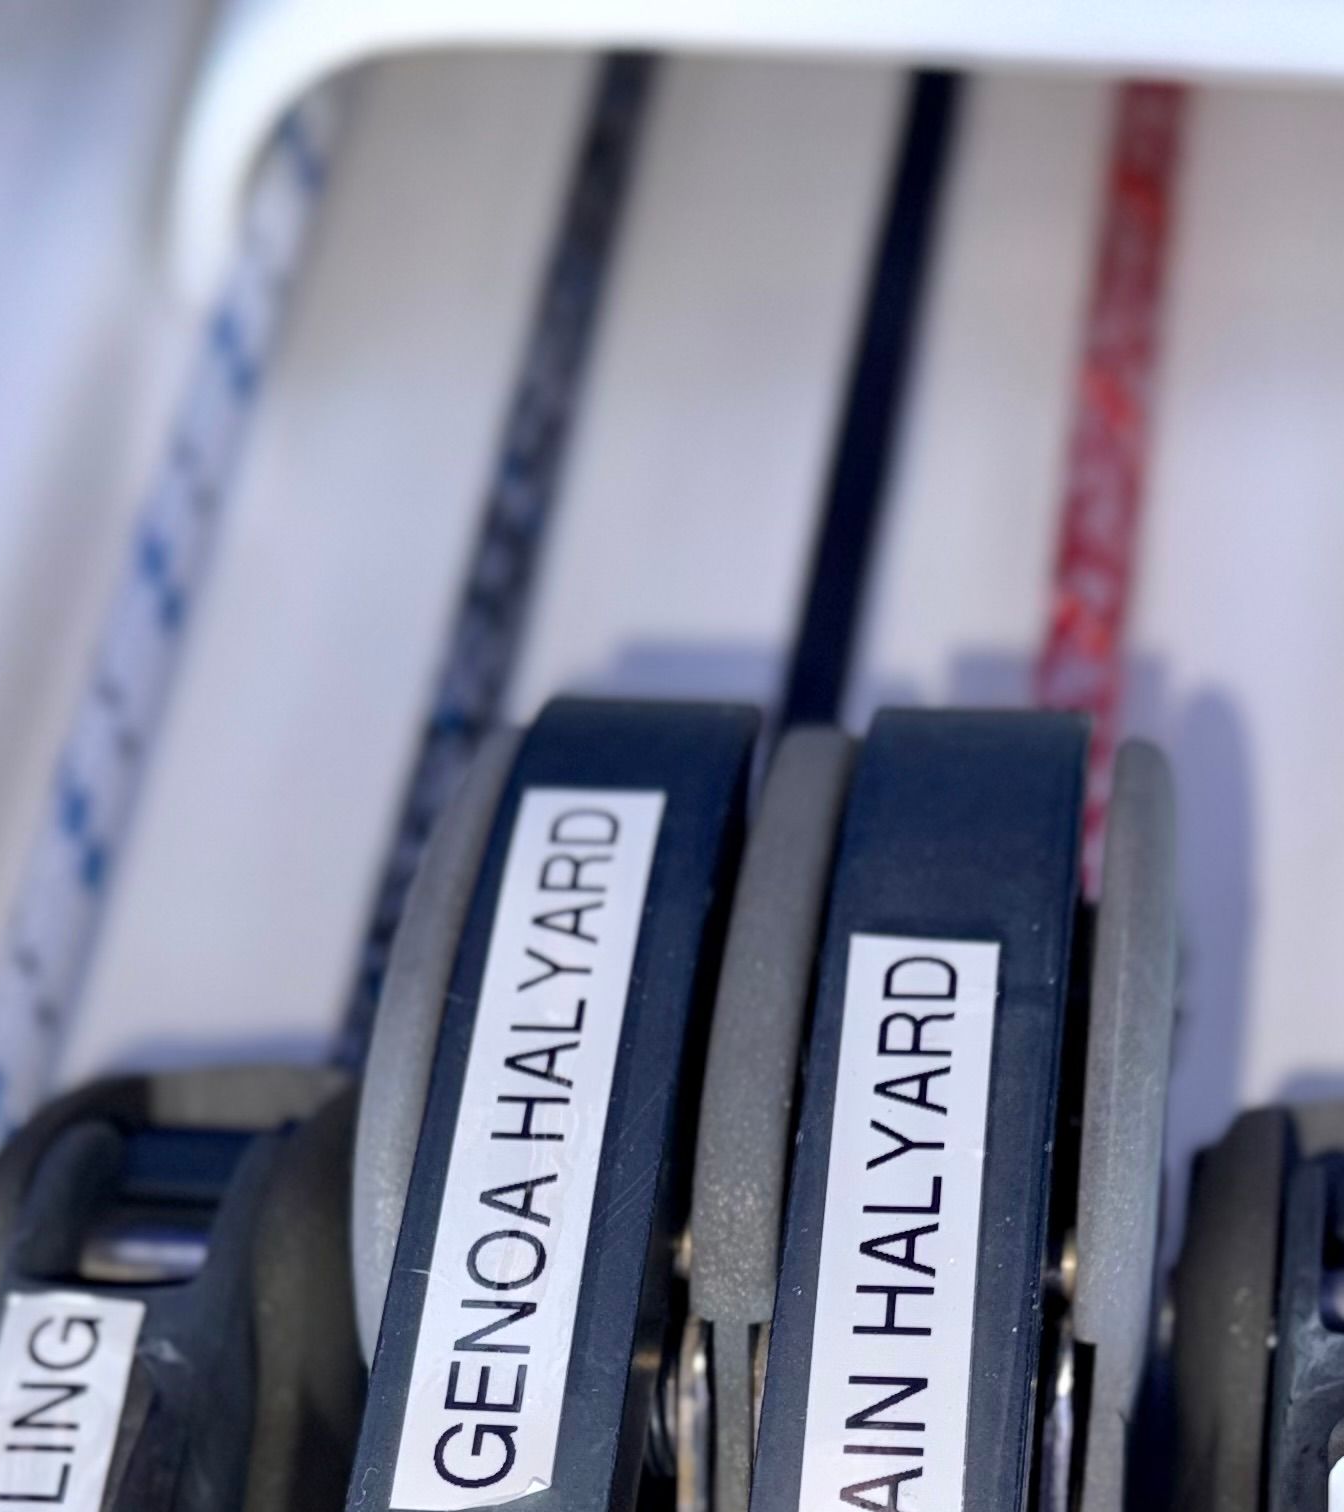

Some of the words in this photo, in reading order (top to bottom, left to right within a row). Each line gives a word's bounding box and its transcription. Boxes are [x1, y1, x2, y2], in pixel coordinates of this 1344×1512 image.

[490, 805, 620, 1142] HALYARD
[852, 955, 958, 1337] HALYARD
[433, 1173, 558, 1489] GENOA
